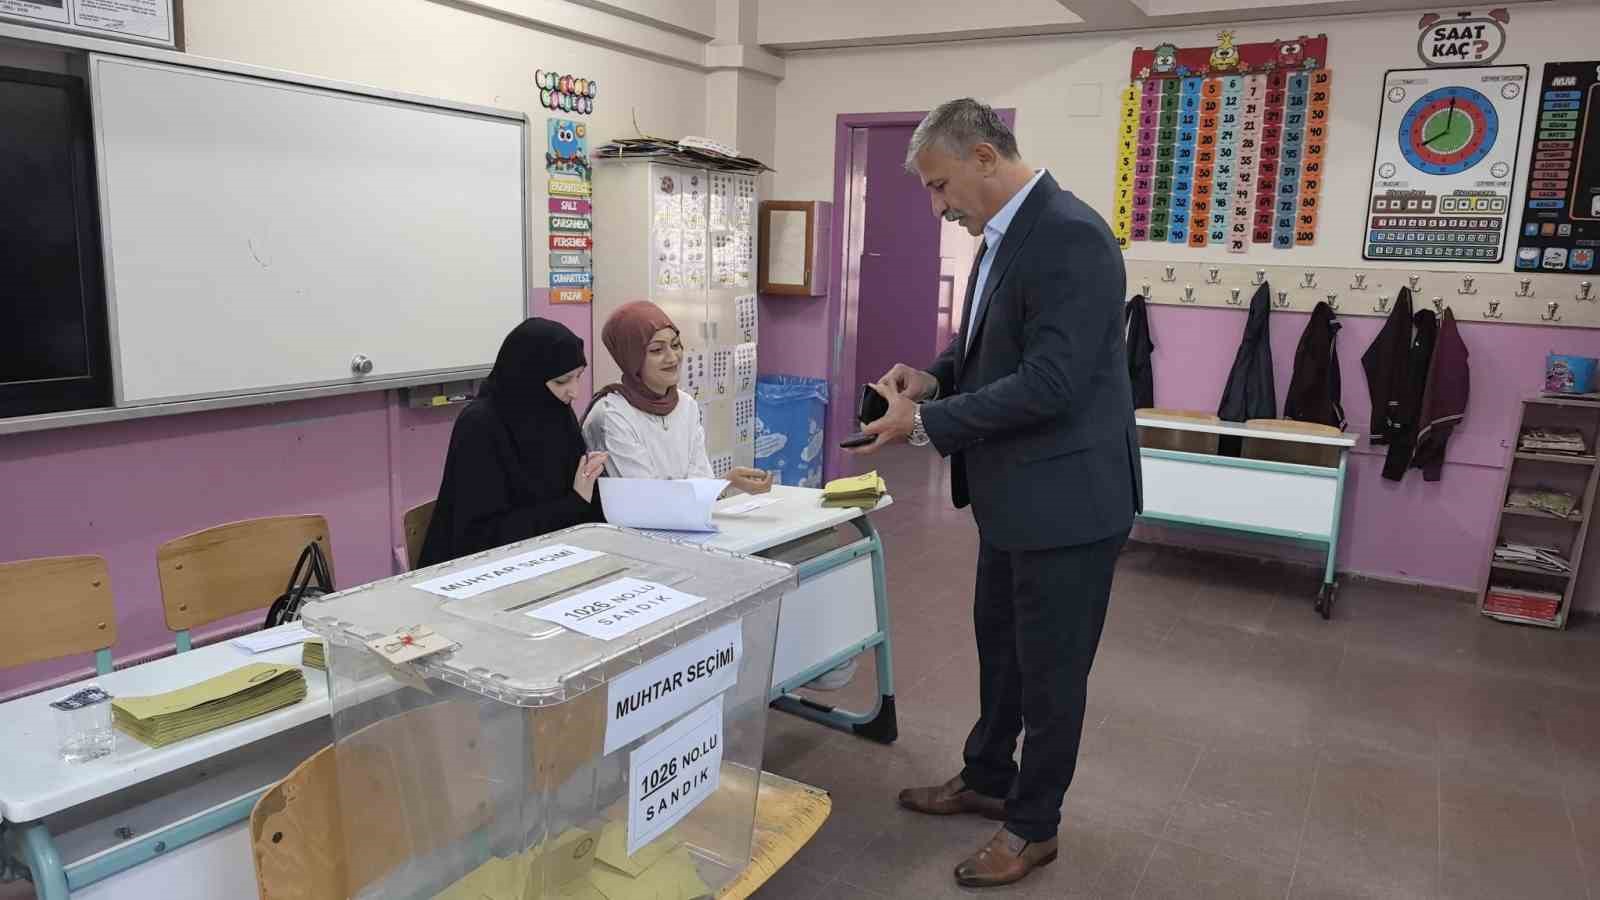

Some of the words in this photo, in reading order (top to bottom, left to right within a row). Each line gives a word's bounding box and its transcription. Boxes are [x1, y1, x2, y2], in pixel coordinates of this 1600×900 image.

[1434, 25, 1486, 42] SAAT
[1432, 40, 1489, 60] KAÇ?
[1316, 74, 1327, 83] 10
[1189, 82, 1194, 90] 4
[1230, 80, 1236, 88] 6
[1129, 92, 1134, 100] 1
[1250, 87, 1256, 96] 7
[1313, 92, 1325, 101] 20
[1187, 98, 1193, 107] 8
[1226, 97, 1237, 106] 12
[1128, 109, 1133, 117] 2
[1246, 104, 1256, 113] 14
[1224, 114, 1235, 123] 18
[1312, 110, 1324, 119] 30
[1182, 115, 1193, 124] 12
[1126, 125, 1132, 133] 3
[1244, 121, 1255, 130] 21
[1182, 132, 1191, 141] 16
[1222, 131, 1232, 140] 24
[1310, 128, 1322, 136] 40
[1125, 141, 1130, 149] 4
[1242, 139, 1254, 148] 28
[1180, 149, 1190, 157] 20
[1220, 148, 1232, 157] 30
[1308, 145, 1320, 154] 50
[1124, 158, 1129, 166] 5
[1241, 156, 1252, 165] 35
[1179, 165, 1189, 174] 24
[1219, 165, 1230, 174] 36
[1307, 163, 1318, 172] 60
[1122, 174, 1128, 182] 6
[1240, 173, 1250, 182] 42
[1177, 182, 1187, 190] 28
[1217, 182, 1227, 190] 42
[1306, 181, 1317, 189] 70
[1121, 190, 1127, 198] 7
[1237, 190, 1248, 199] 49
[1176, 199, 1186, 207] 32
[1216, 199, 1226, 207] 48
[1303, 198, 1315, 207] 80
[1120, 206, 1125, 214] 8
[1235, 207, 1247, 216] 56
[1173, 215, 1184, 223] 36
[1214, 215, 1224, 223] 54
[1301, 215, 1312, 224] 90
[1120, 222, 1124, 230] 9
[1233, 224, 1245, 232] 63
[1172, 231, 1183, 240] 40
[1212, 232, 1223, 240] 60
[1297, 232, 1314, 240] 100
[1232, 241, 1243, 249] 70
[440, 566, 519, 591] MUHTAR
[565, 601, 611, 618] 1026
[598, 595, 672, 625] SANDIK
[616, 672, 682, 719] MUHTAR
[687, 642, 734, 682] SEÇİMİ
[641, 757, 677, 794] 1026
[682, 734, 717, 768] NO.LU
[646, 768, 708, 821] SANDIK
